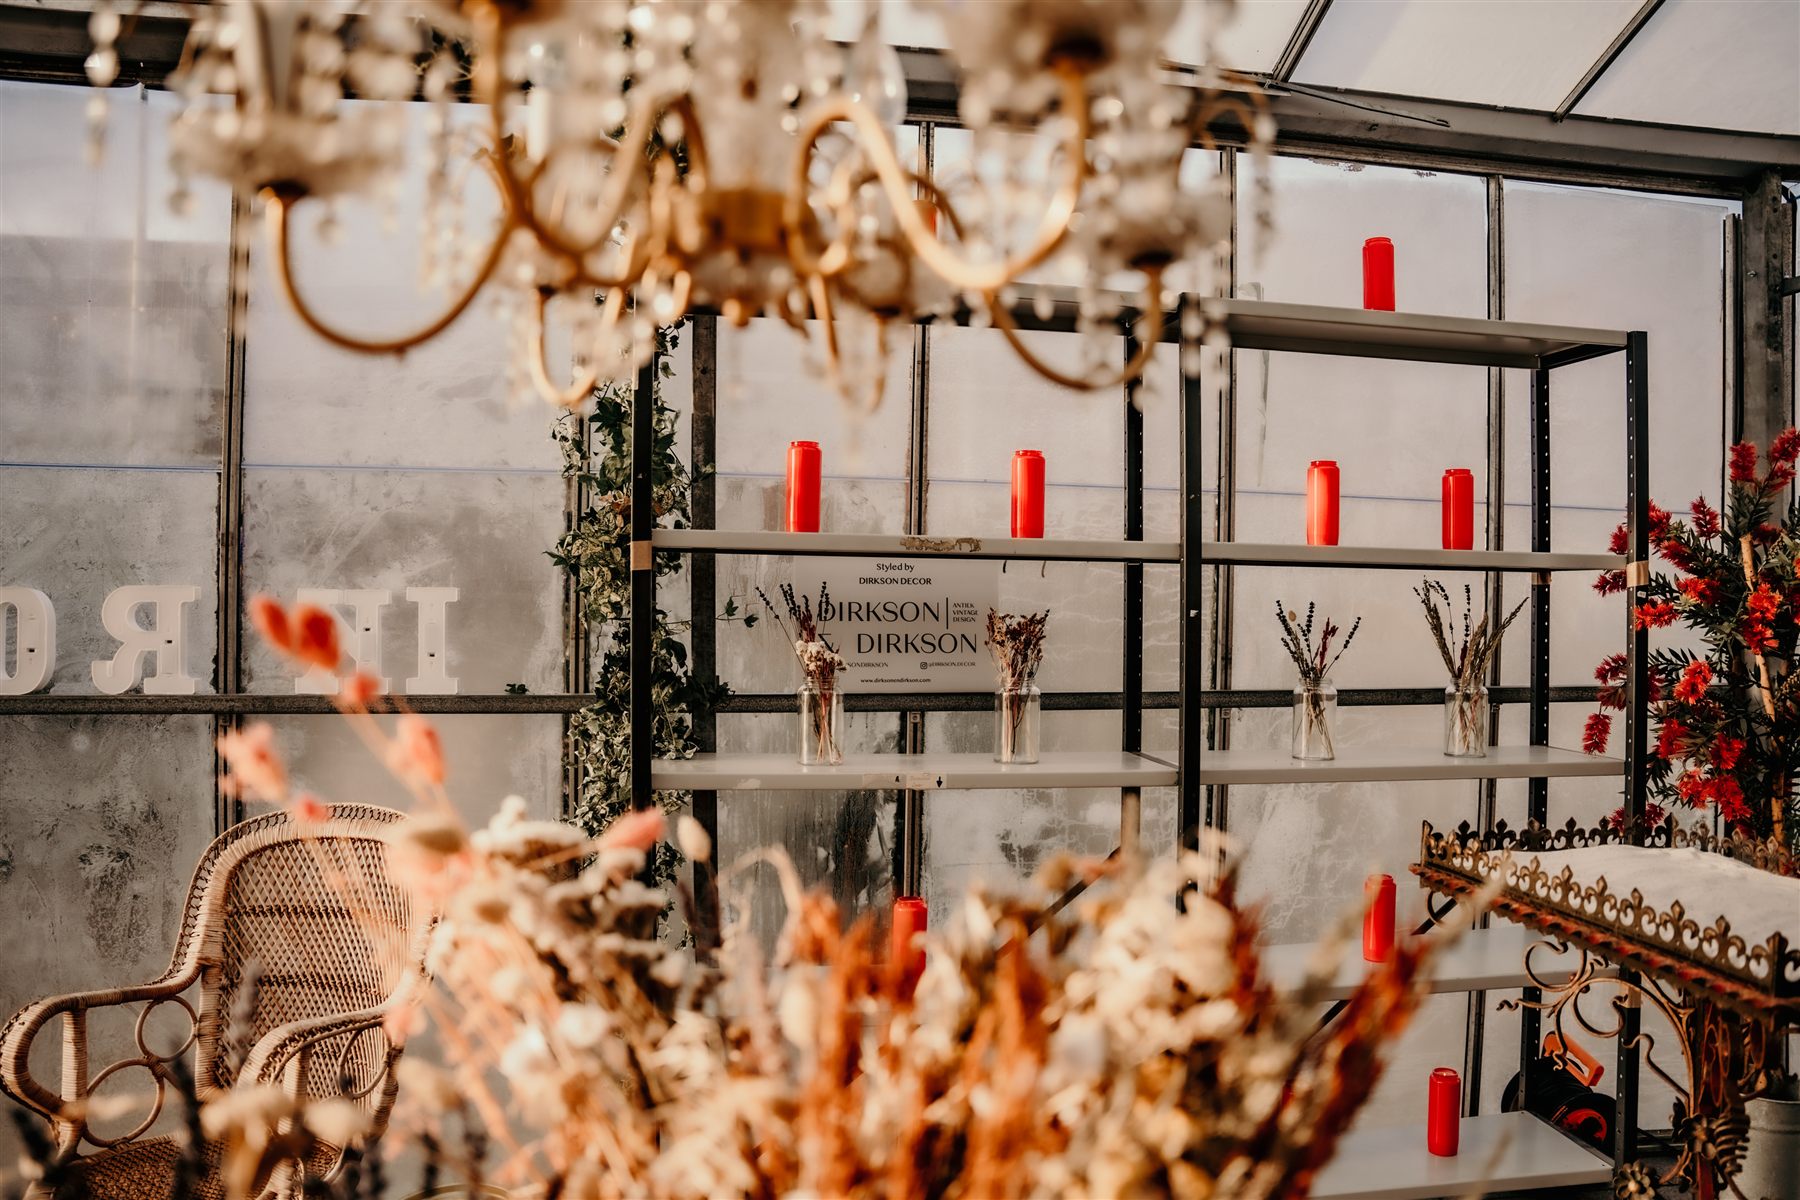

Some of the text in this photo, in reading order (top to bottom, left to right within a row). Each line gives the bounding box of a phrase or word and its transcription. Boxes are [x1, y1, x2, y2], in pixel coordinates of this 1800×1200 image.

[876, 562, 915, 573] Styled by
[859, 577, 932, 586] DIRKSON DECOR
[818, 601, 940, 622] DIRKSON
[857, 633, 977, 654] DIRKSON
